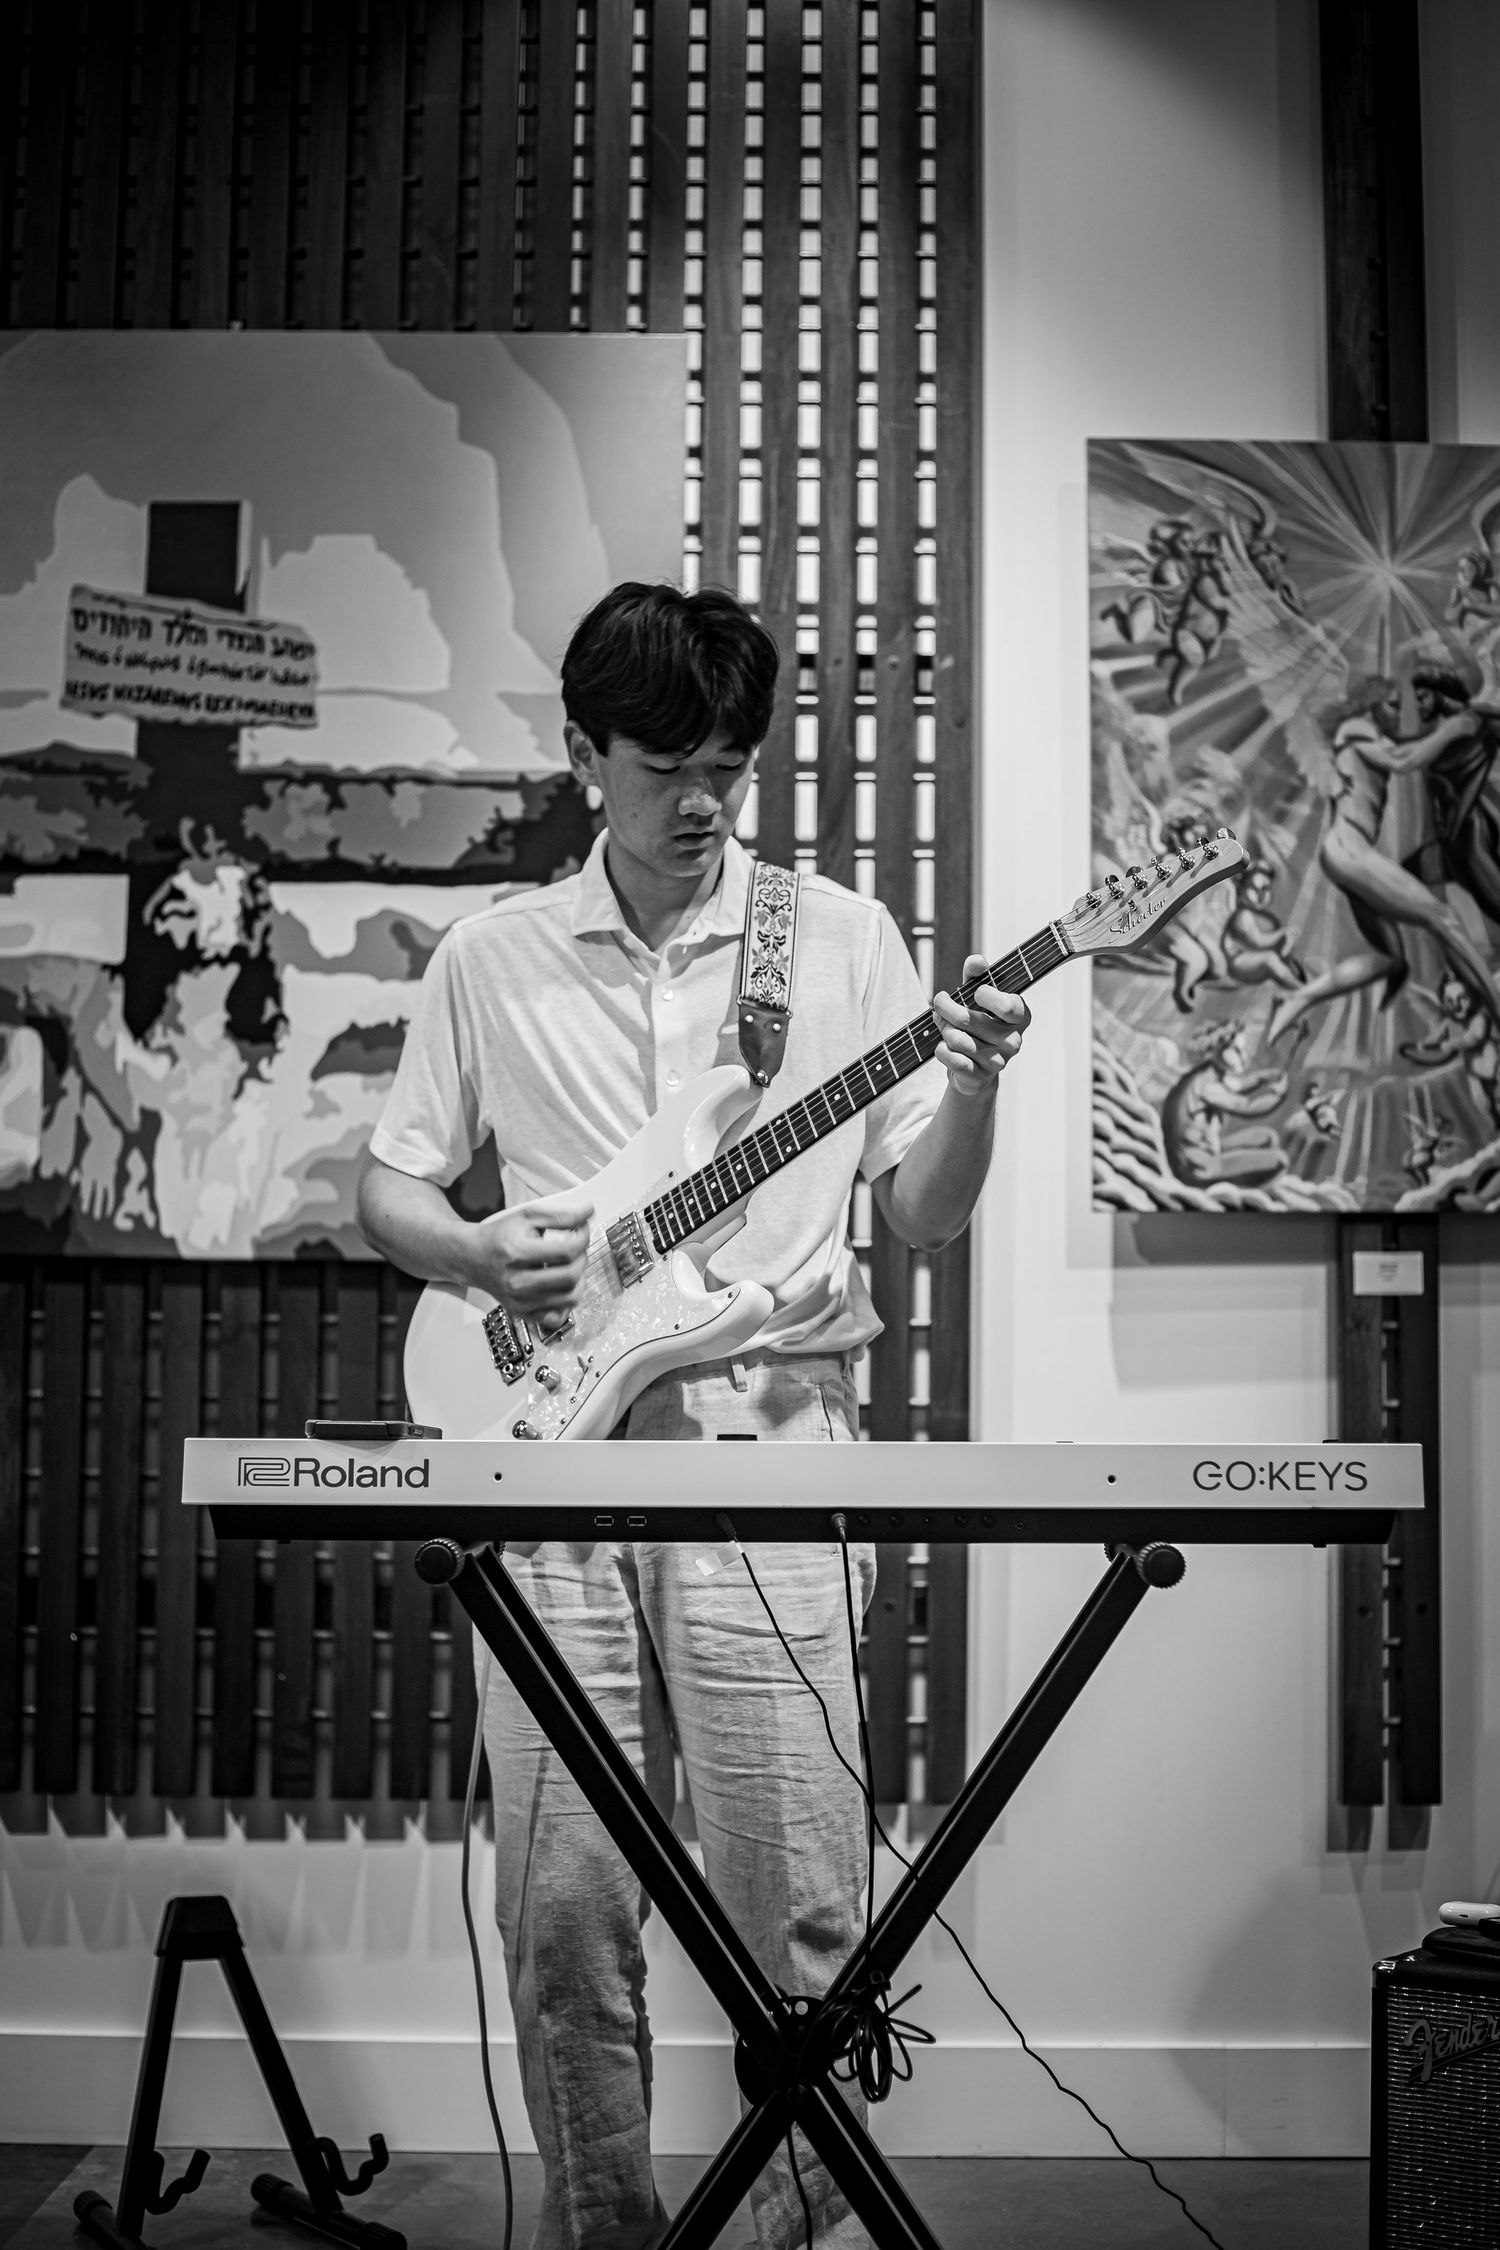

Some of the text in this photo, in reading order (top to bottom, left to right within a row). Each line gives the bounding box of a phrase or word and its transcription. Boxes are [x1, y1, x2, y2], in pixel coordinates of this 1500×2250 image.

[293, 1457, 430, 1489] Roland
[1192, 1460, 1368, 1491] GO:KEYS
[1403, 2013, 1500, 2082] Fender
